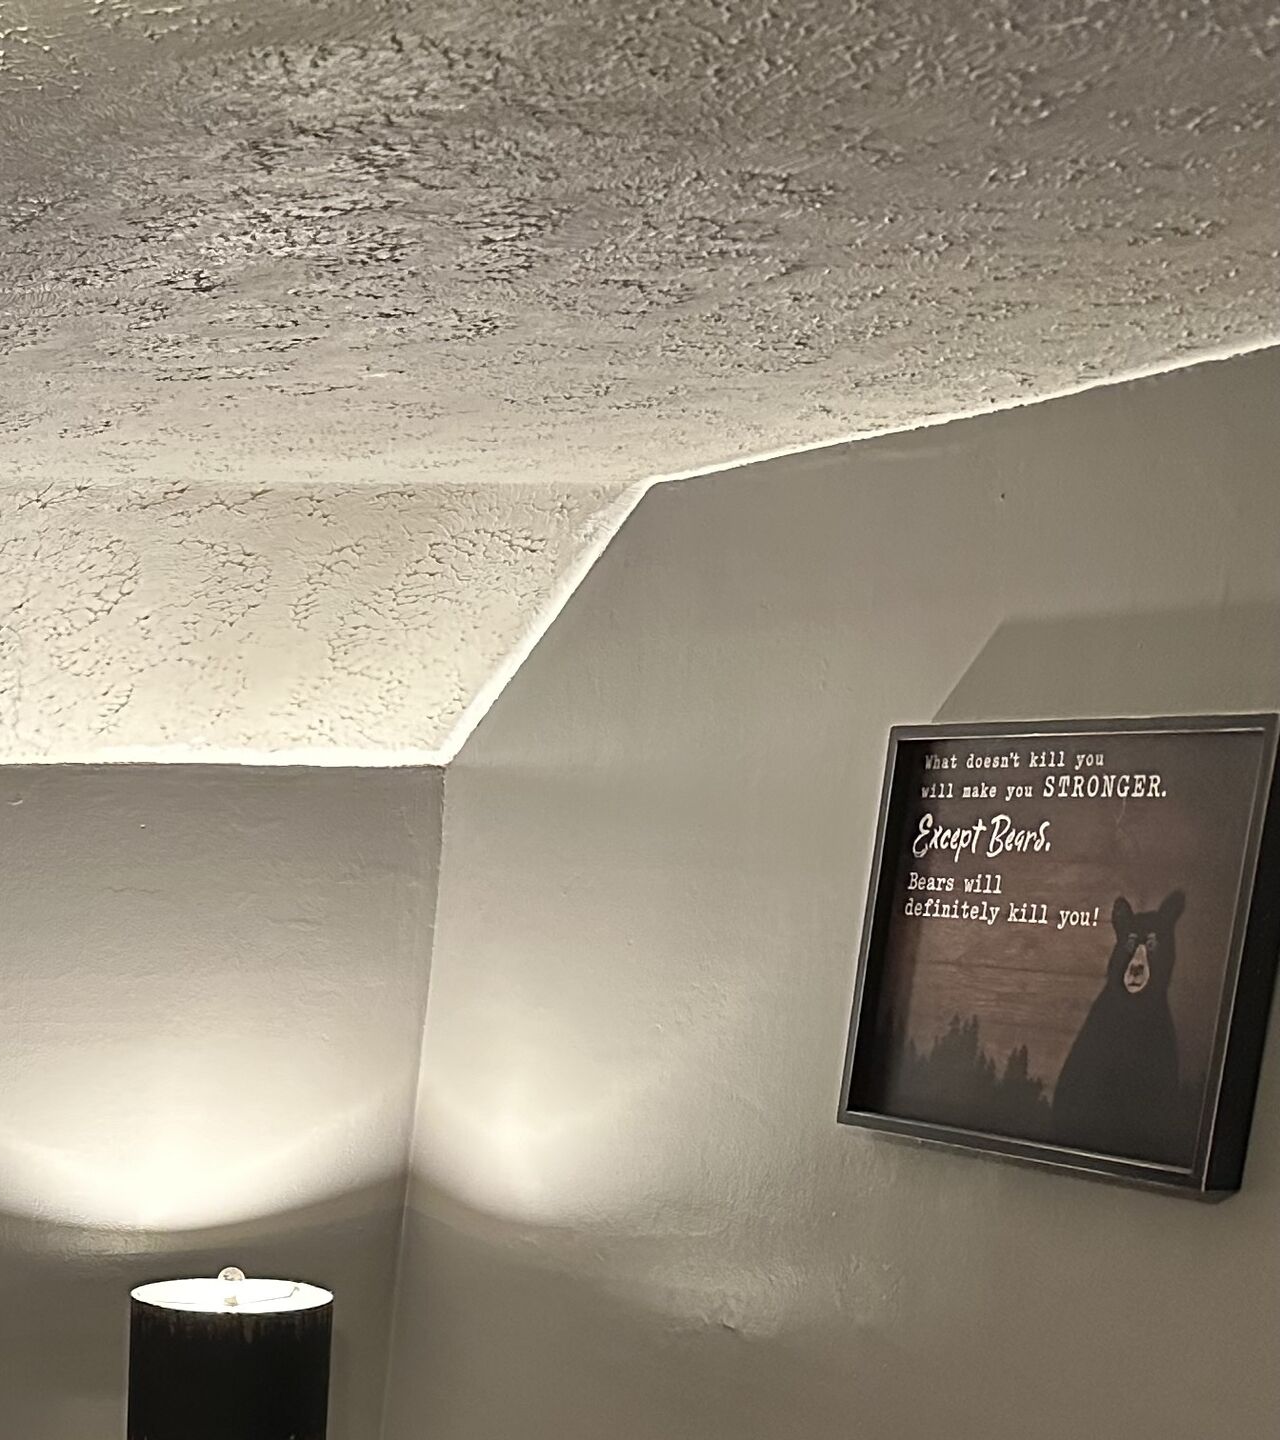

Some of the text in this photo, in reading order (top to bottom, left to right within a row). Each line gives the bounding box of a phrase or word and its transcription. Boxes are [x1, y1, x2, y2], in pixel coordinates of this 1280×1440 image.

[924, 751, 1105, 770] What doesn't kill you
[921, 774, 1168, 802] will make you STRONGER.
[912, 813, 1052, 863] Except Bears.
[907, 871, 1002, 894] Bears will
[904, 898, 1100, 930] definitely kill you!
